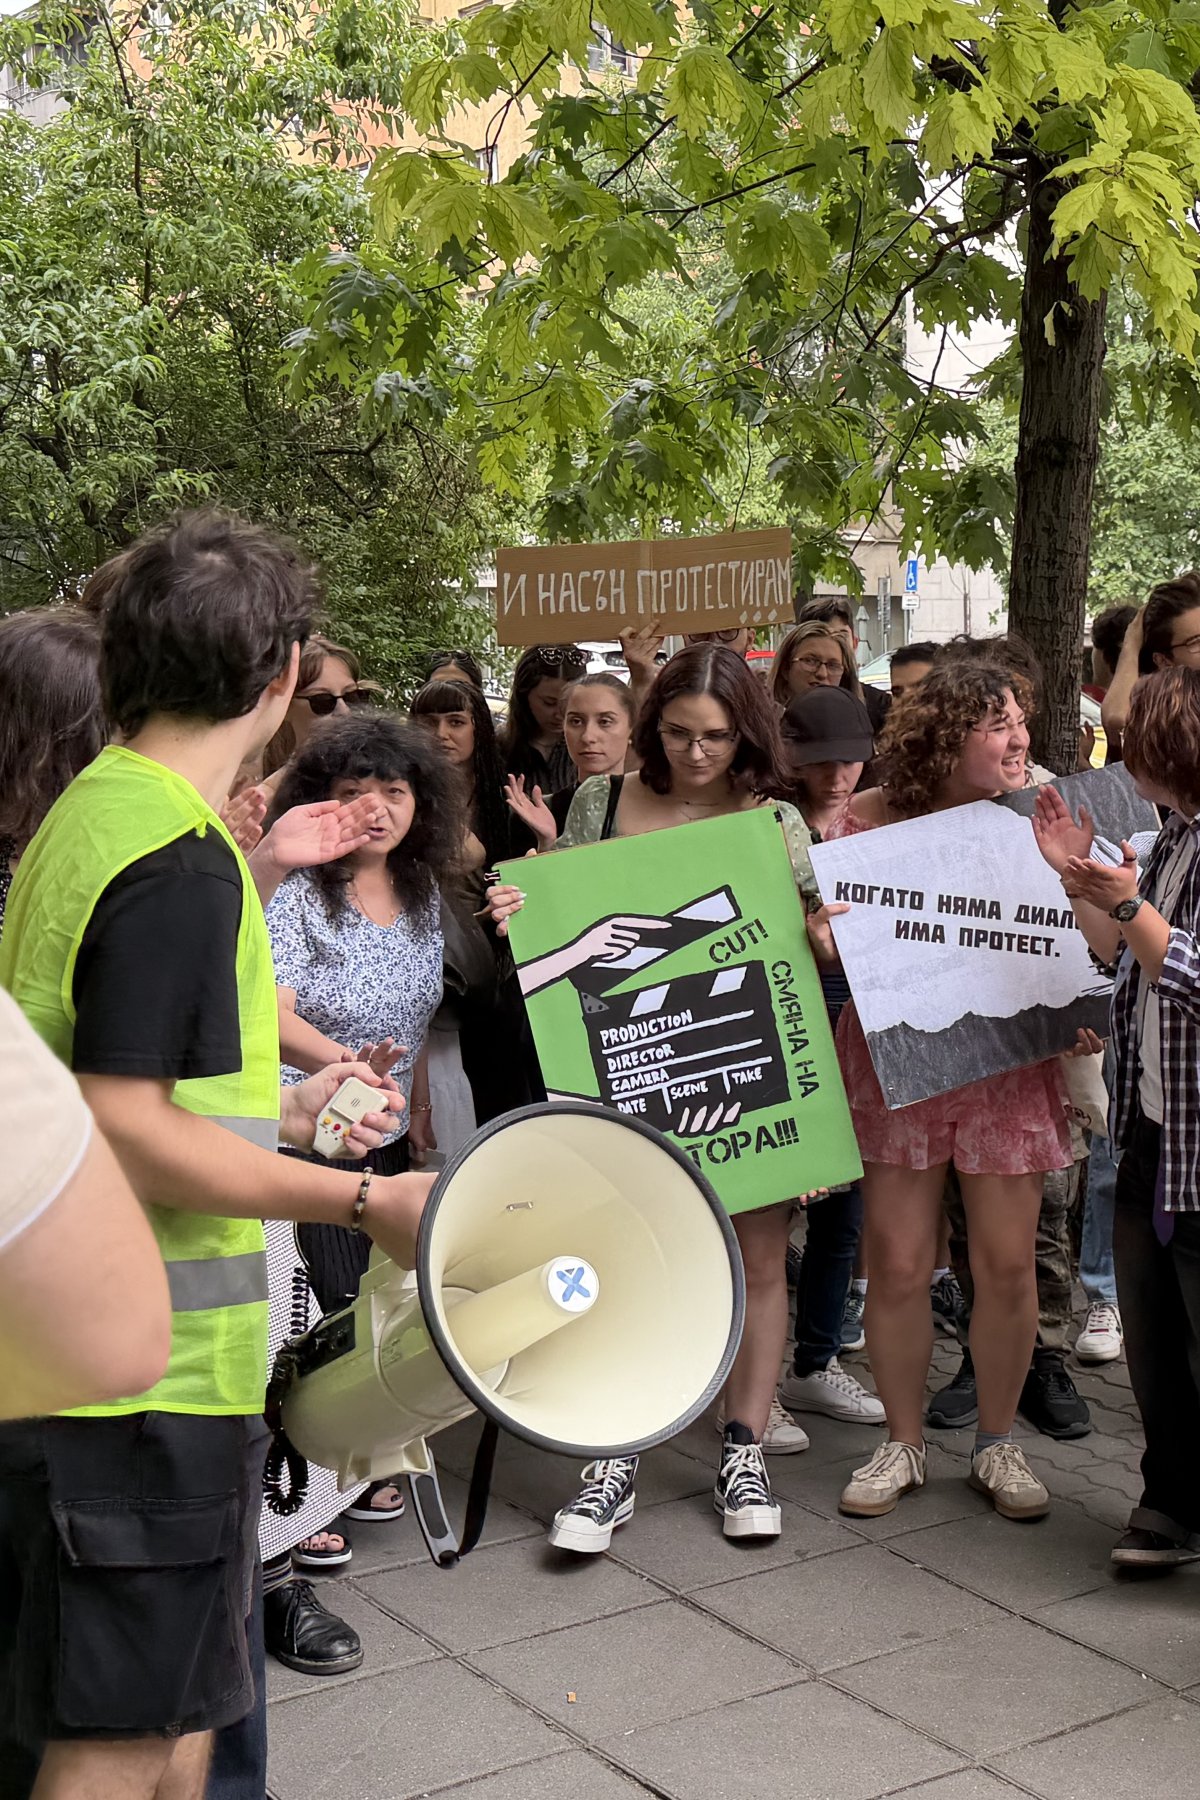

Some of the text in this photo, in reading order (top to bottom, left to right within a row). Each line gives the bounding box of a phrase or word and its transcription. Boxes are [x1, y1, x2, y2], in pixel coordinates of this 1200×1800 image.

[503, 557, 792, 617] И НАСЪН ПРОТЕСТИРАМ
[835, 881, 1080, 930] КОГАТО НЯМА ДИАЛ
[709, 918, 769, 964] CUT!
[895, 920, 1061, 957] ИМА ПРОТЕСТ.
[600, 1009, 693, 1047] PRODUCTION
[771, 960, 820, 1099] СМЯНА НА
[607, 1043, 675, 1072] DIRECTOR
[611, 1068, 670, 1092] CAMERA
[617, 1067, 763, 1114] DATE SCENE TAKE
[683, 1117, 800, 1168] ТОРА!!!
